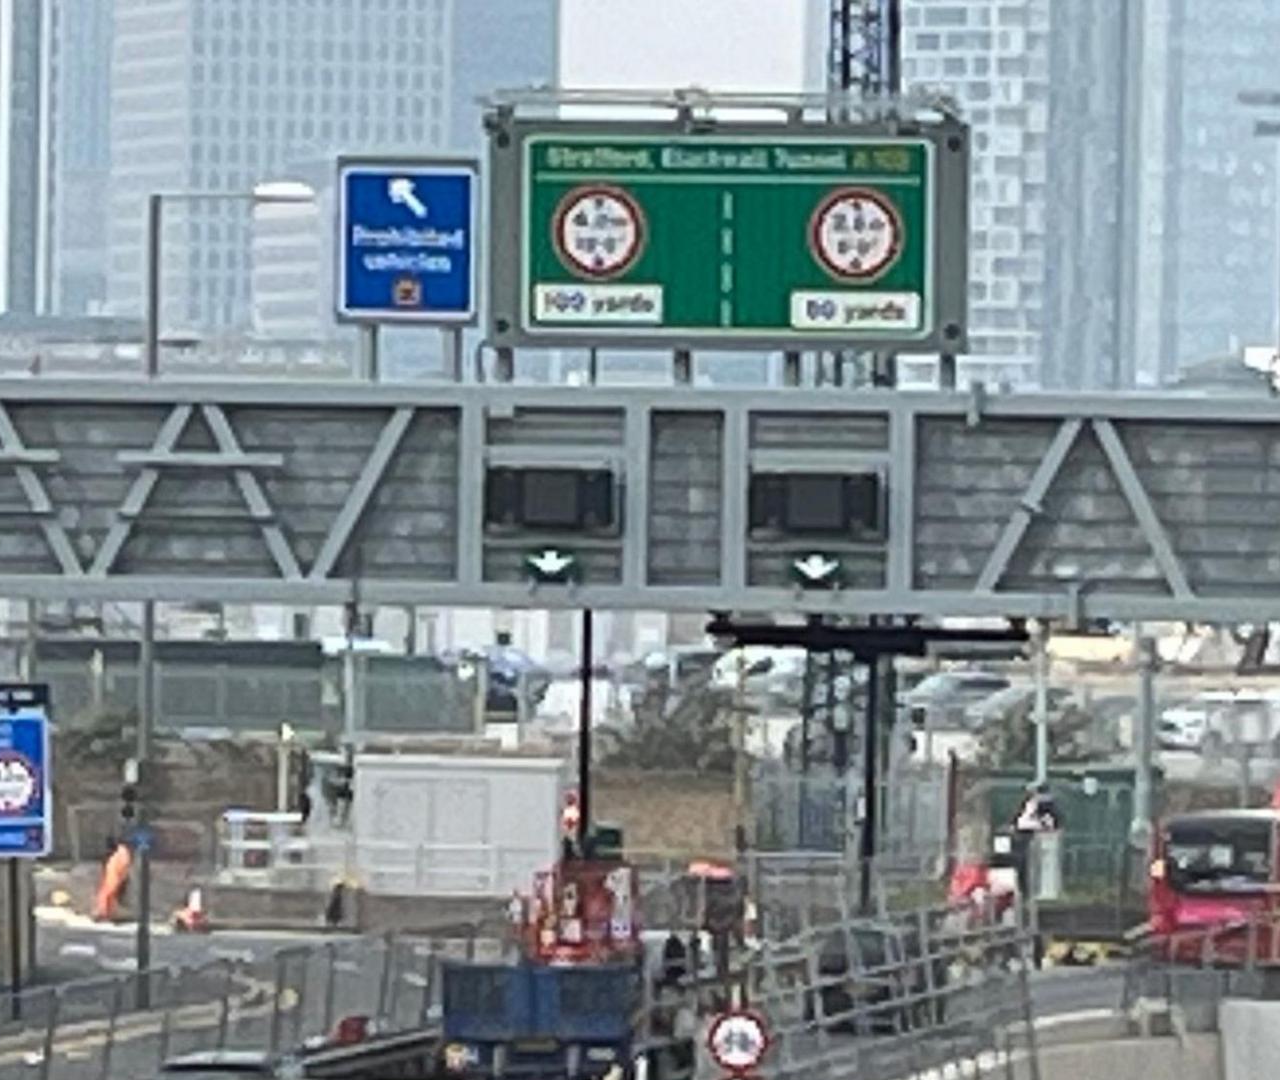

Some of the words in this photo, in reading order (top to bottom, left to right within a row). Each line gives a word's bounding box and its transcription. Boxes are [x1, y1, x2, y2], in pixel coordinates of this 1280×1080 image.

[773, 146, 847, 169] Tunnel
[591, 292, 655, 315] yards
[843, 302, 907, 324] yards
